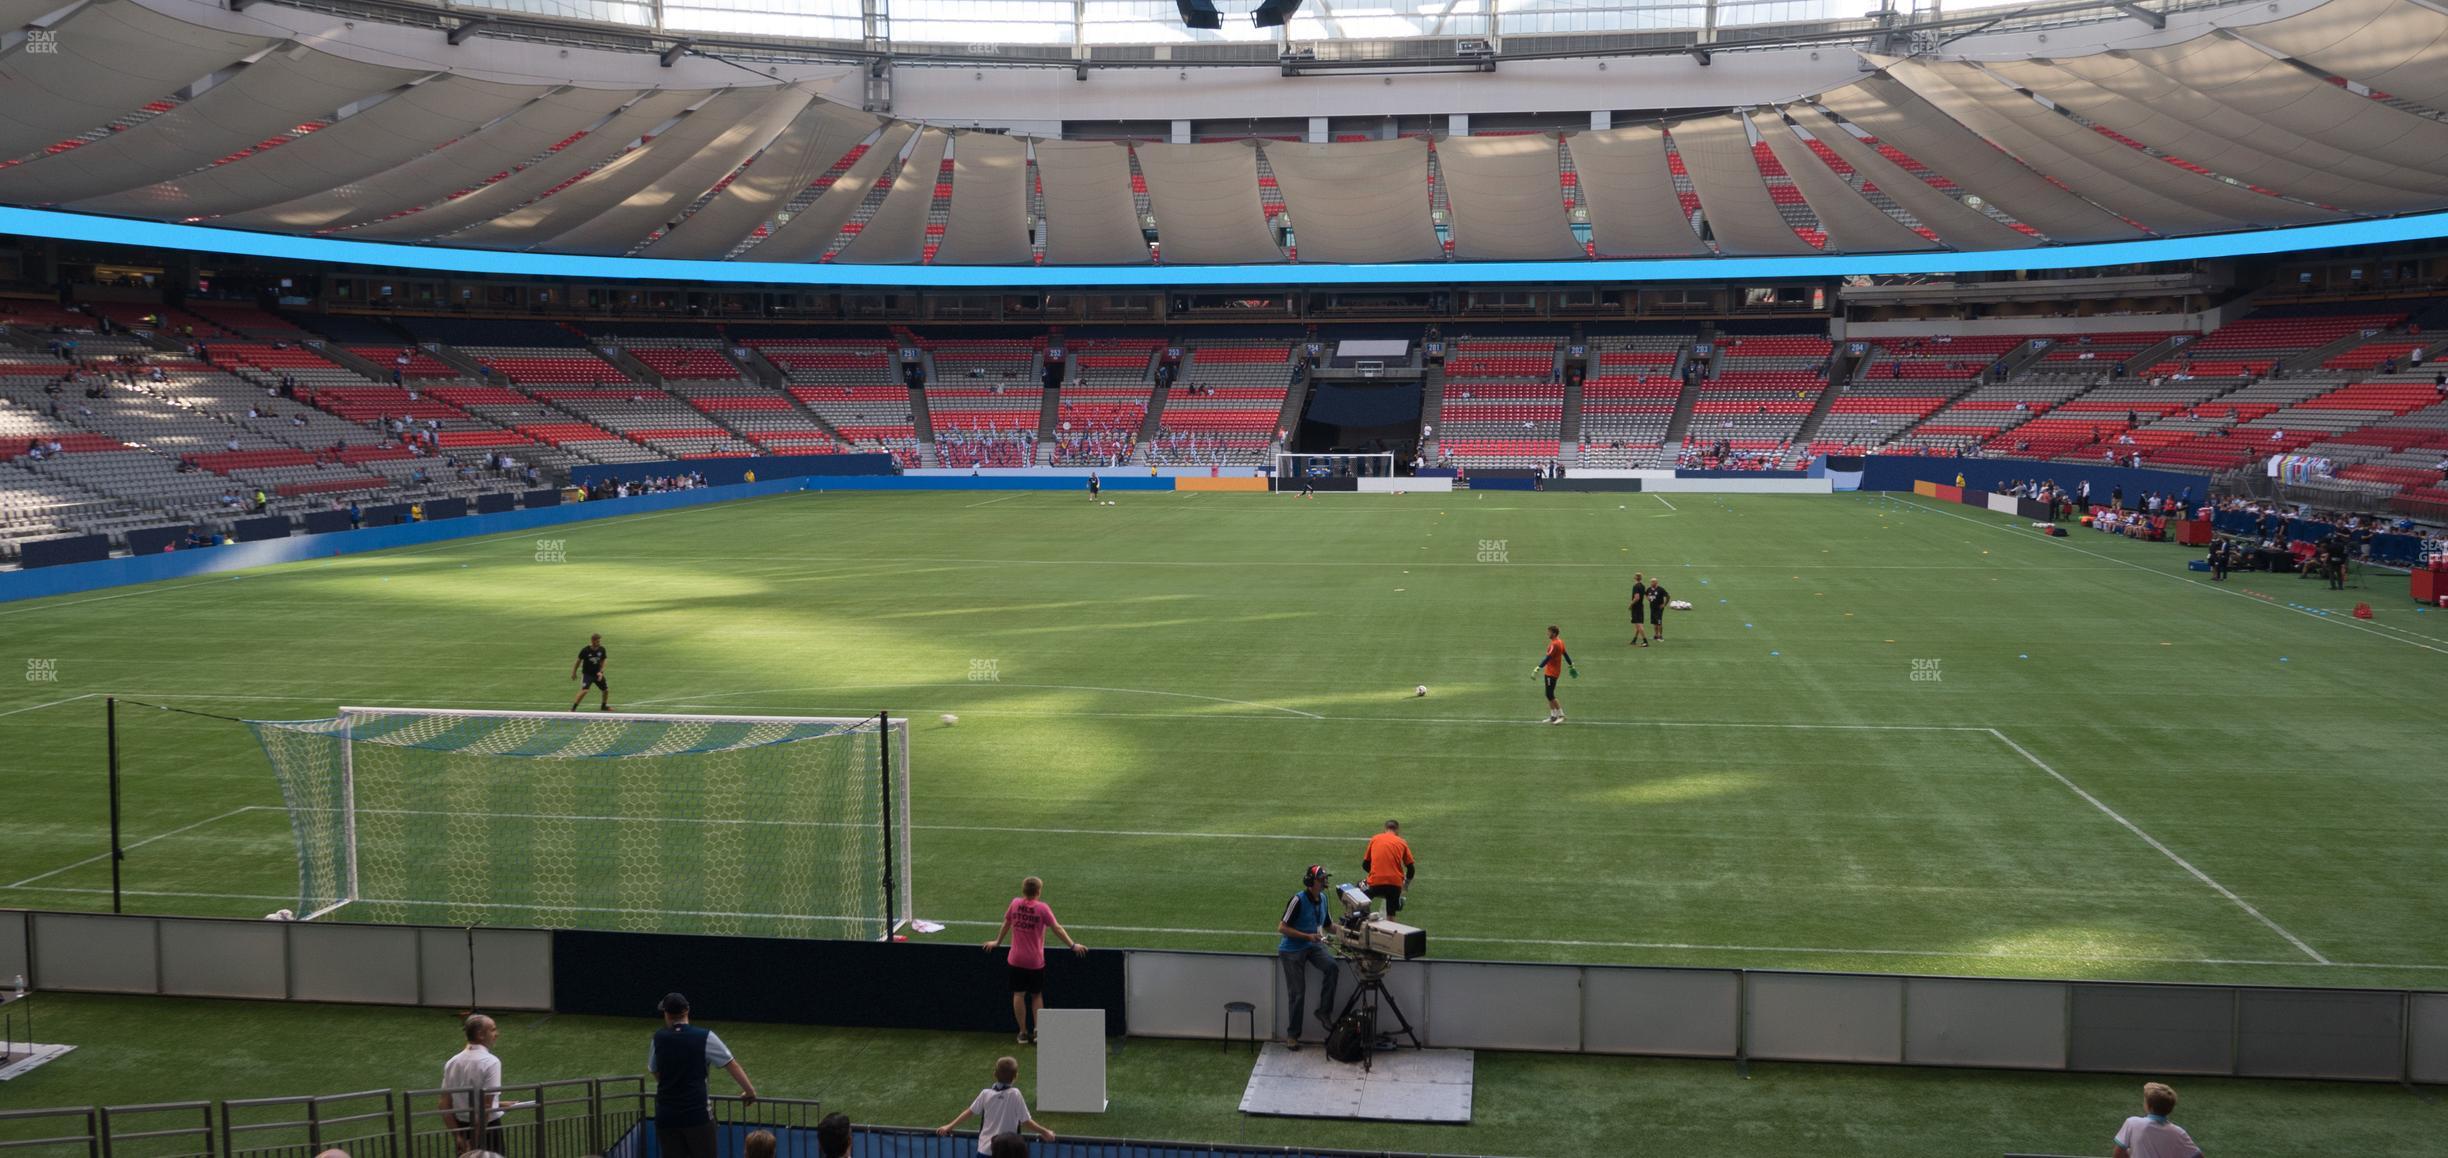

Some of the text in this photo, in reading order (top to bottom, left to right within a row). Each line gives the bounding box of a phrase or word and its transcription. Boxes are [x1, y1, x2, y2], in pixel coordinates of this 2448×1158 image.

[1427, 343, 1440, 351] 201
[903, 349, 916, 357] 251
[1012, 913, 1040, 923] STORE
